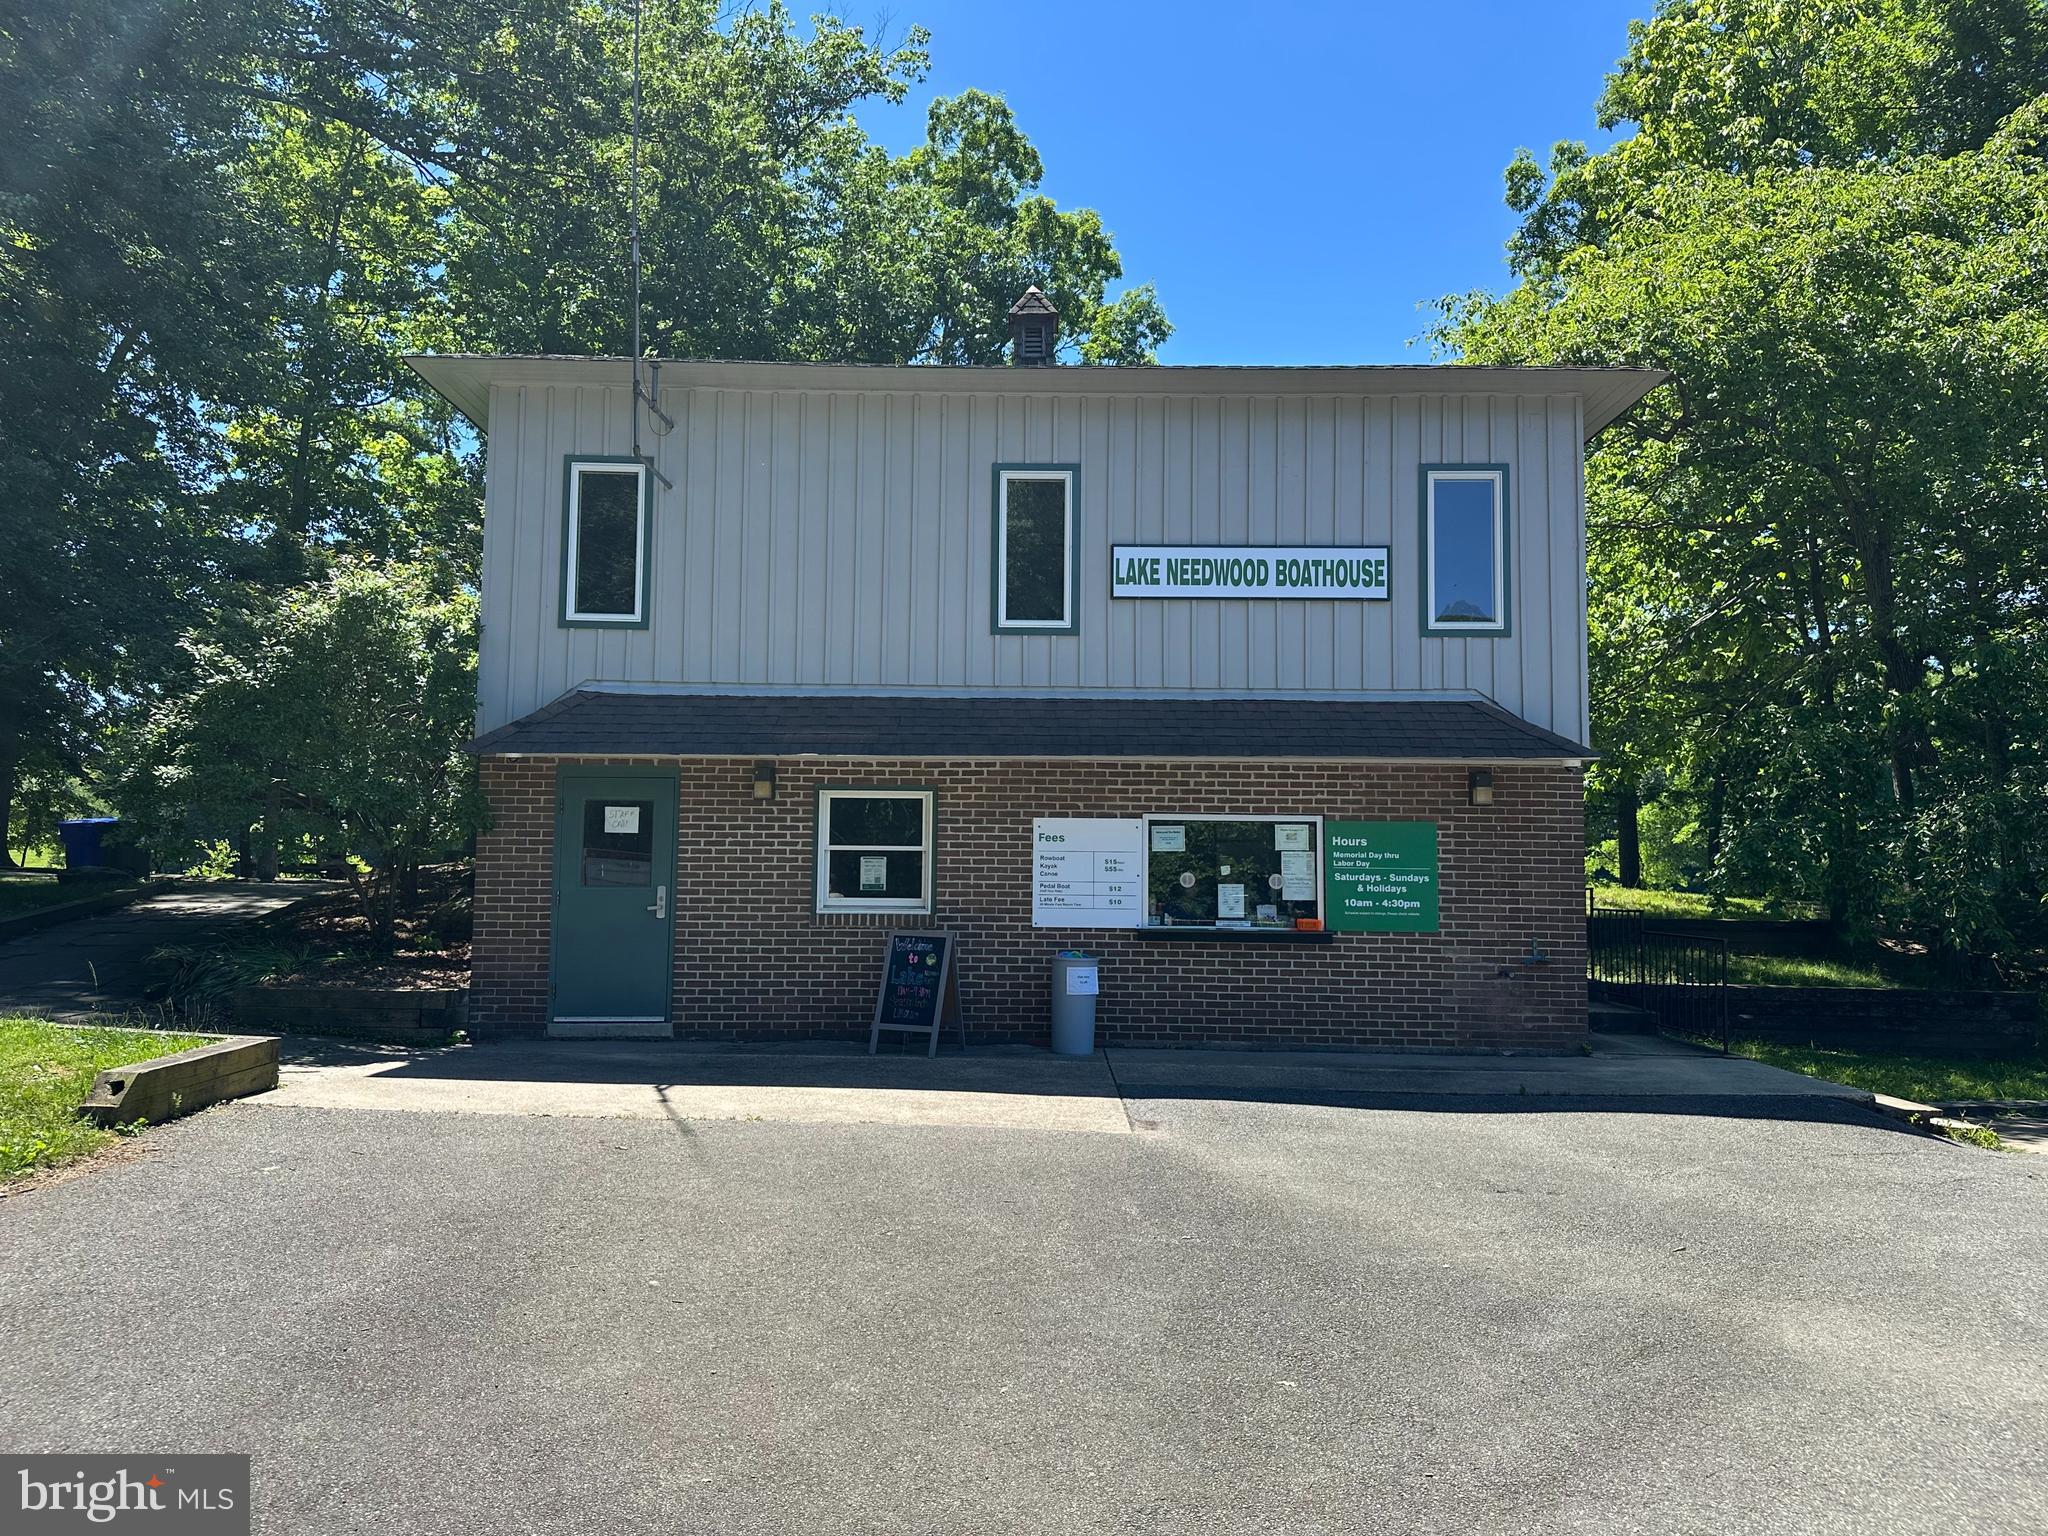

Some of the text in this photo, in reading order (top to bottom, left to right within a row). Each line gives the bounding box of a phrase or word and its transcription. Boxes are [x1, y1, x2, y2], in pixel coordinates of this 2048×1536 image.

[1115, 558, 1385, 587] LAKE NEEDWOOD BOATHOUSE
[1038, 833, 1065, 842] Fees
[1332, 836, 1368, 846] Hours
[1368, 852, 1383, 860] Day
[1356, 860, 1370, 868] Day
[1334, 872, 1381, 883] Saturdays
[1389, 873, 1430, 883] Sundays
[1357, 884, 1407, 894] & Holidays
[1344, 899, 1373, 907] 10am
[1381, 899, 1421, 909] 4:30pm
[908, 952, 919, 964] to
[890, 964, 924, 985] Lake
